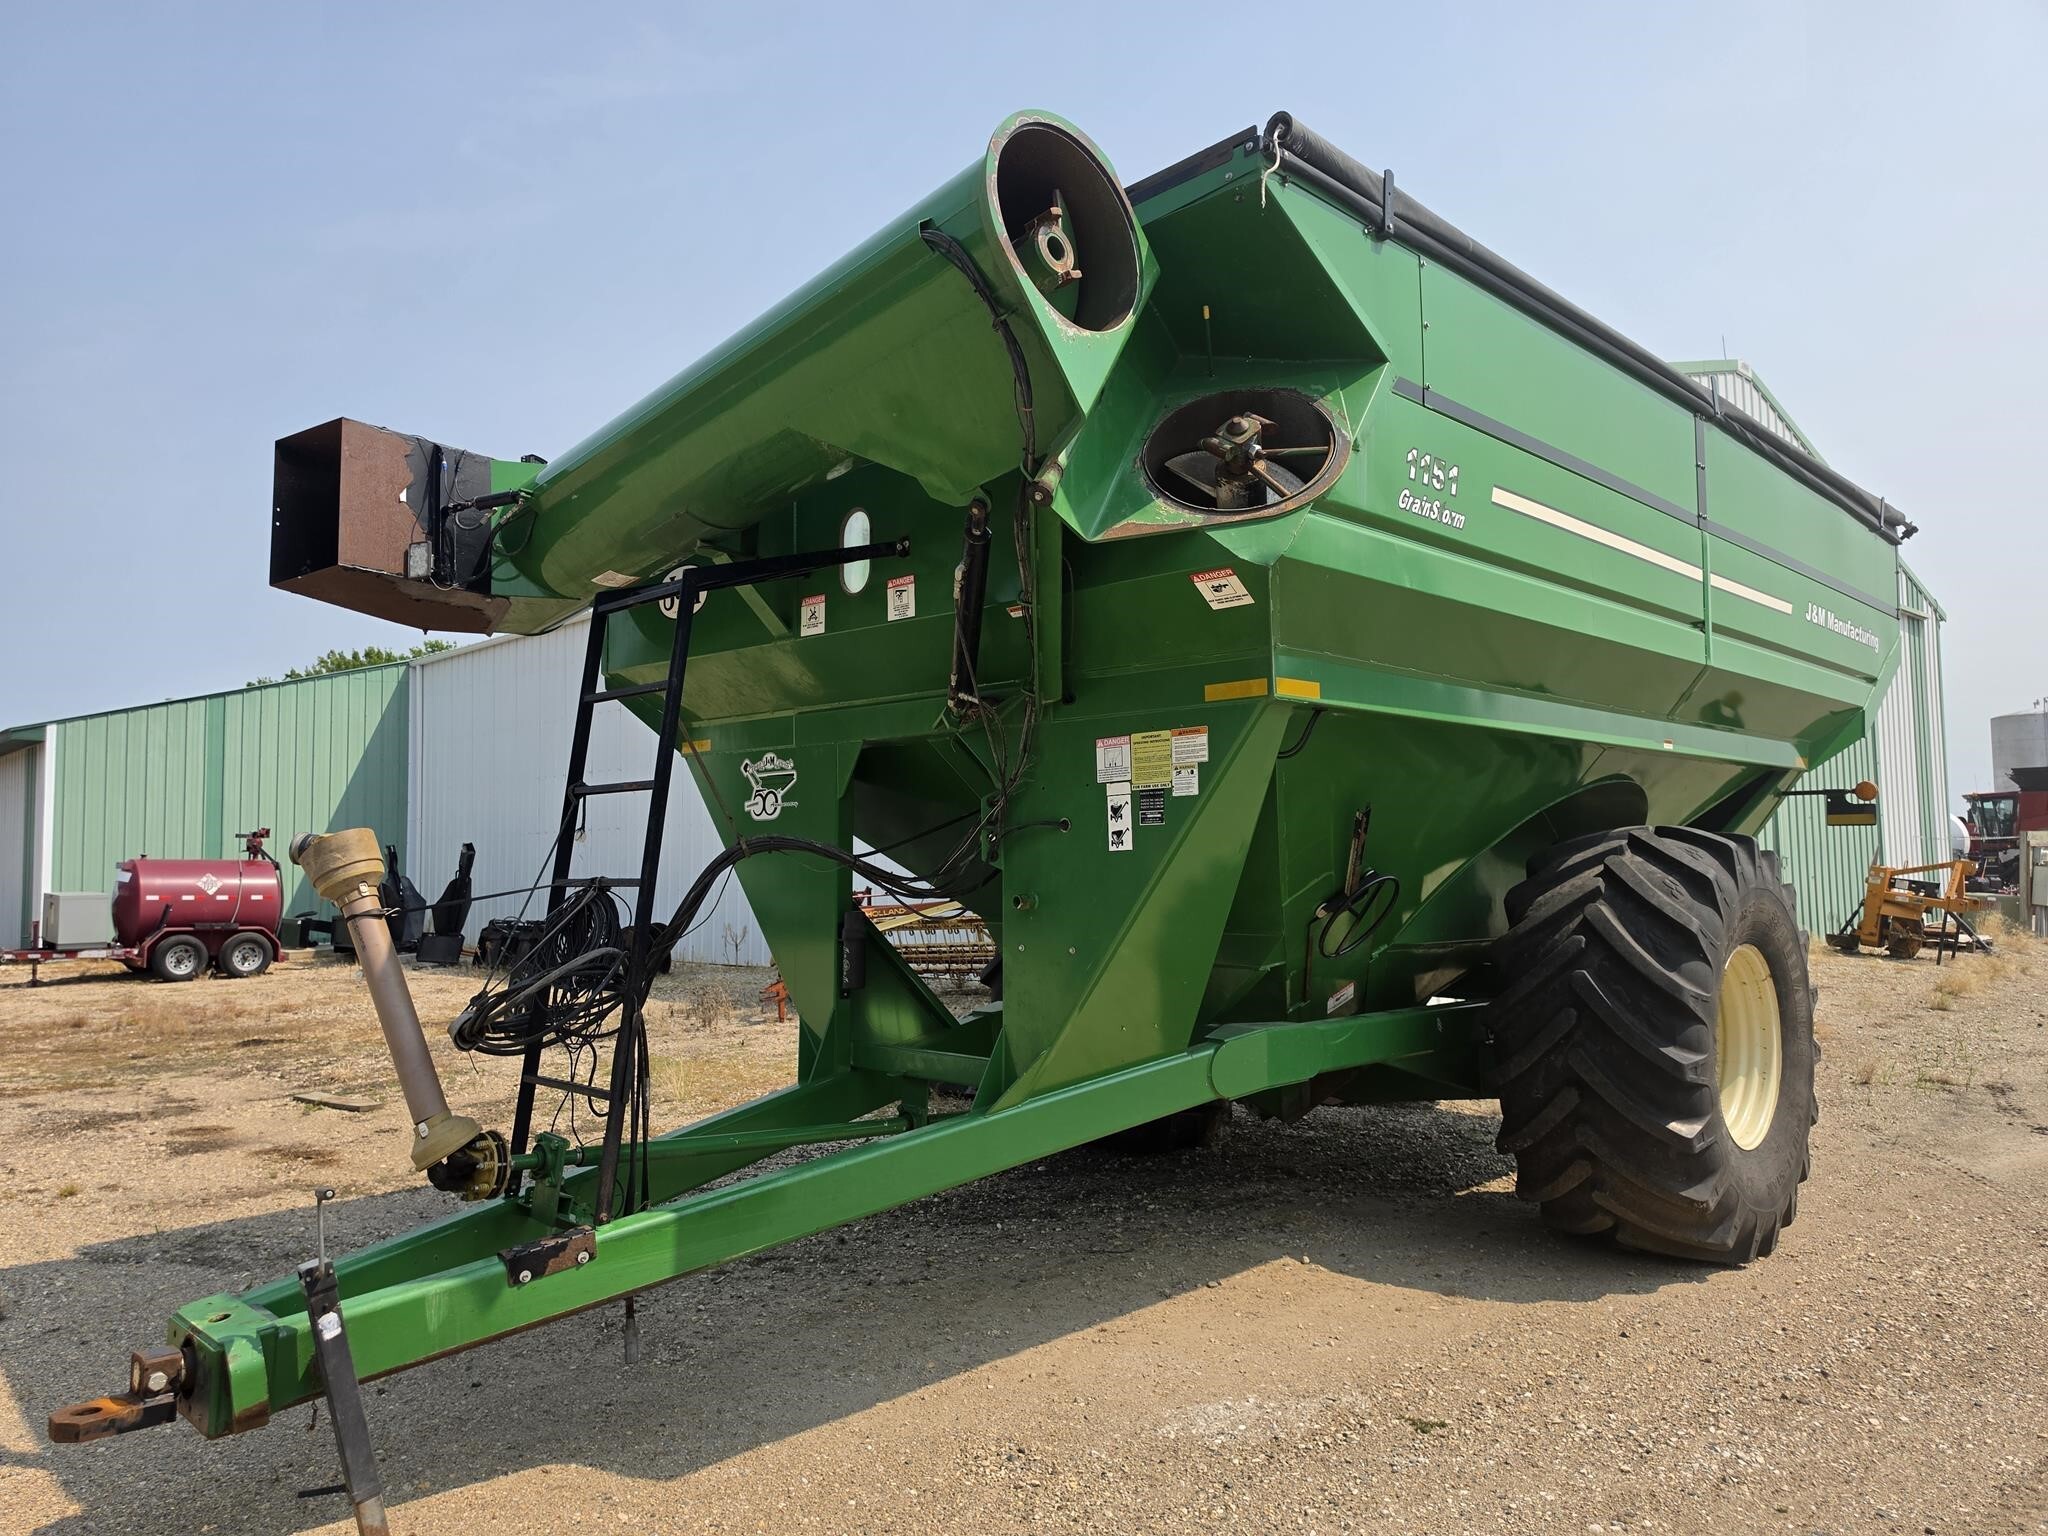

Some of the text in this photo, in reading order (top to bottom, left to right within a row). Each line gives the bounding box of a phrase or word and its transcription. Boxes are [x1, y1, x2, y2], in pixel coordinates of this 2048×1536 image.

[1406, 447, 1459, 497] 1151
[1398, 488, 1466, 530] GrainSorm
[891, 575, 914, 586] DANGER
[1200, 569, 1234, 581] DANGER
[805, 595, 825, 604] DANGER
[1805, 601, 1879, 654] J&M Manufacturing
[1103, 737, 1130, 746] DANGER
[753, 789, 779, 817] 50
[867, 908, 906, 917] HOLLAND
